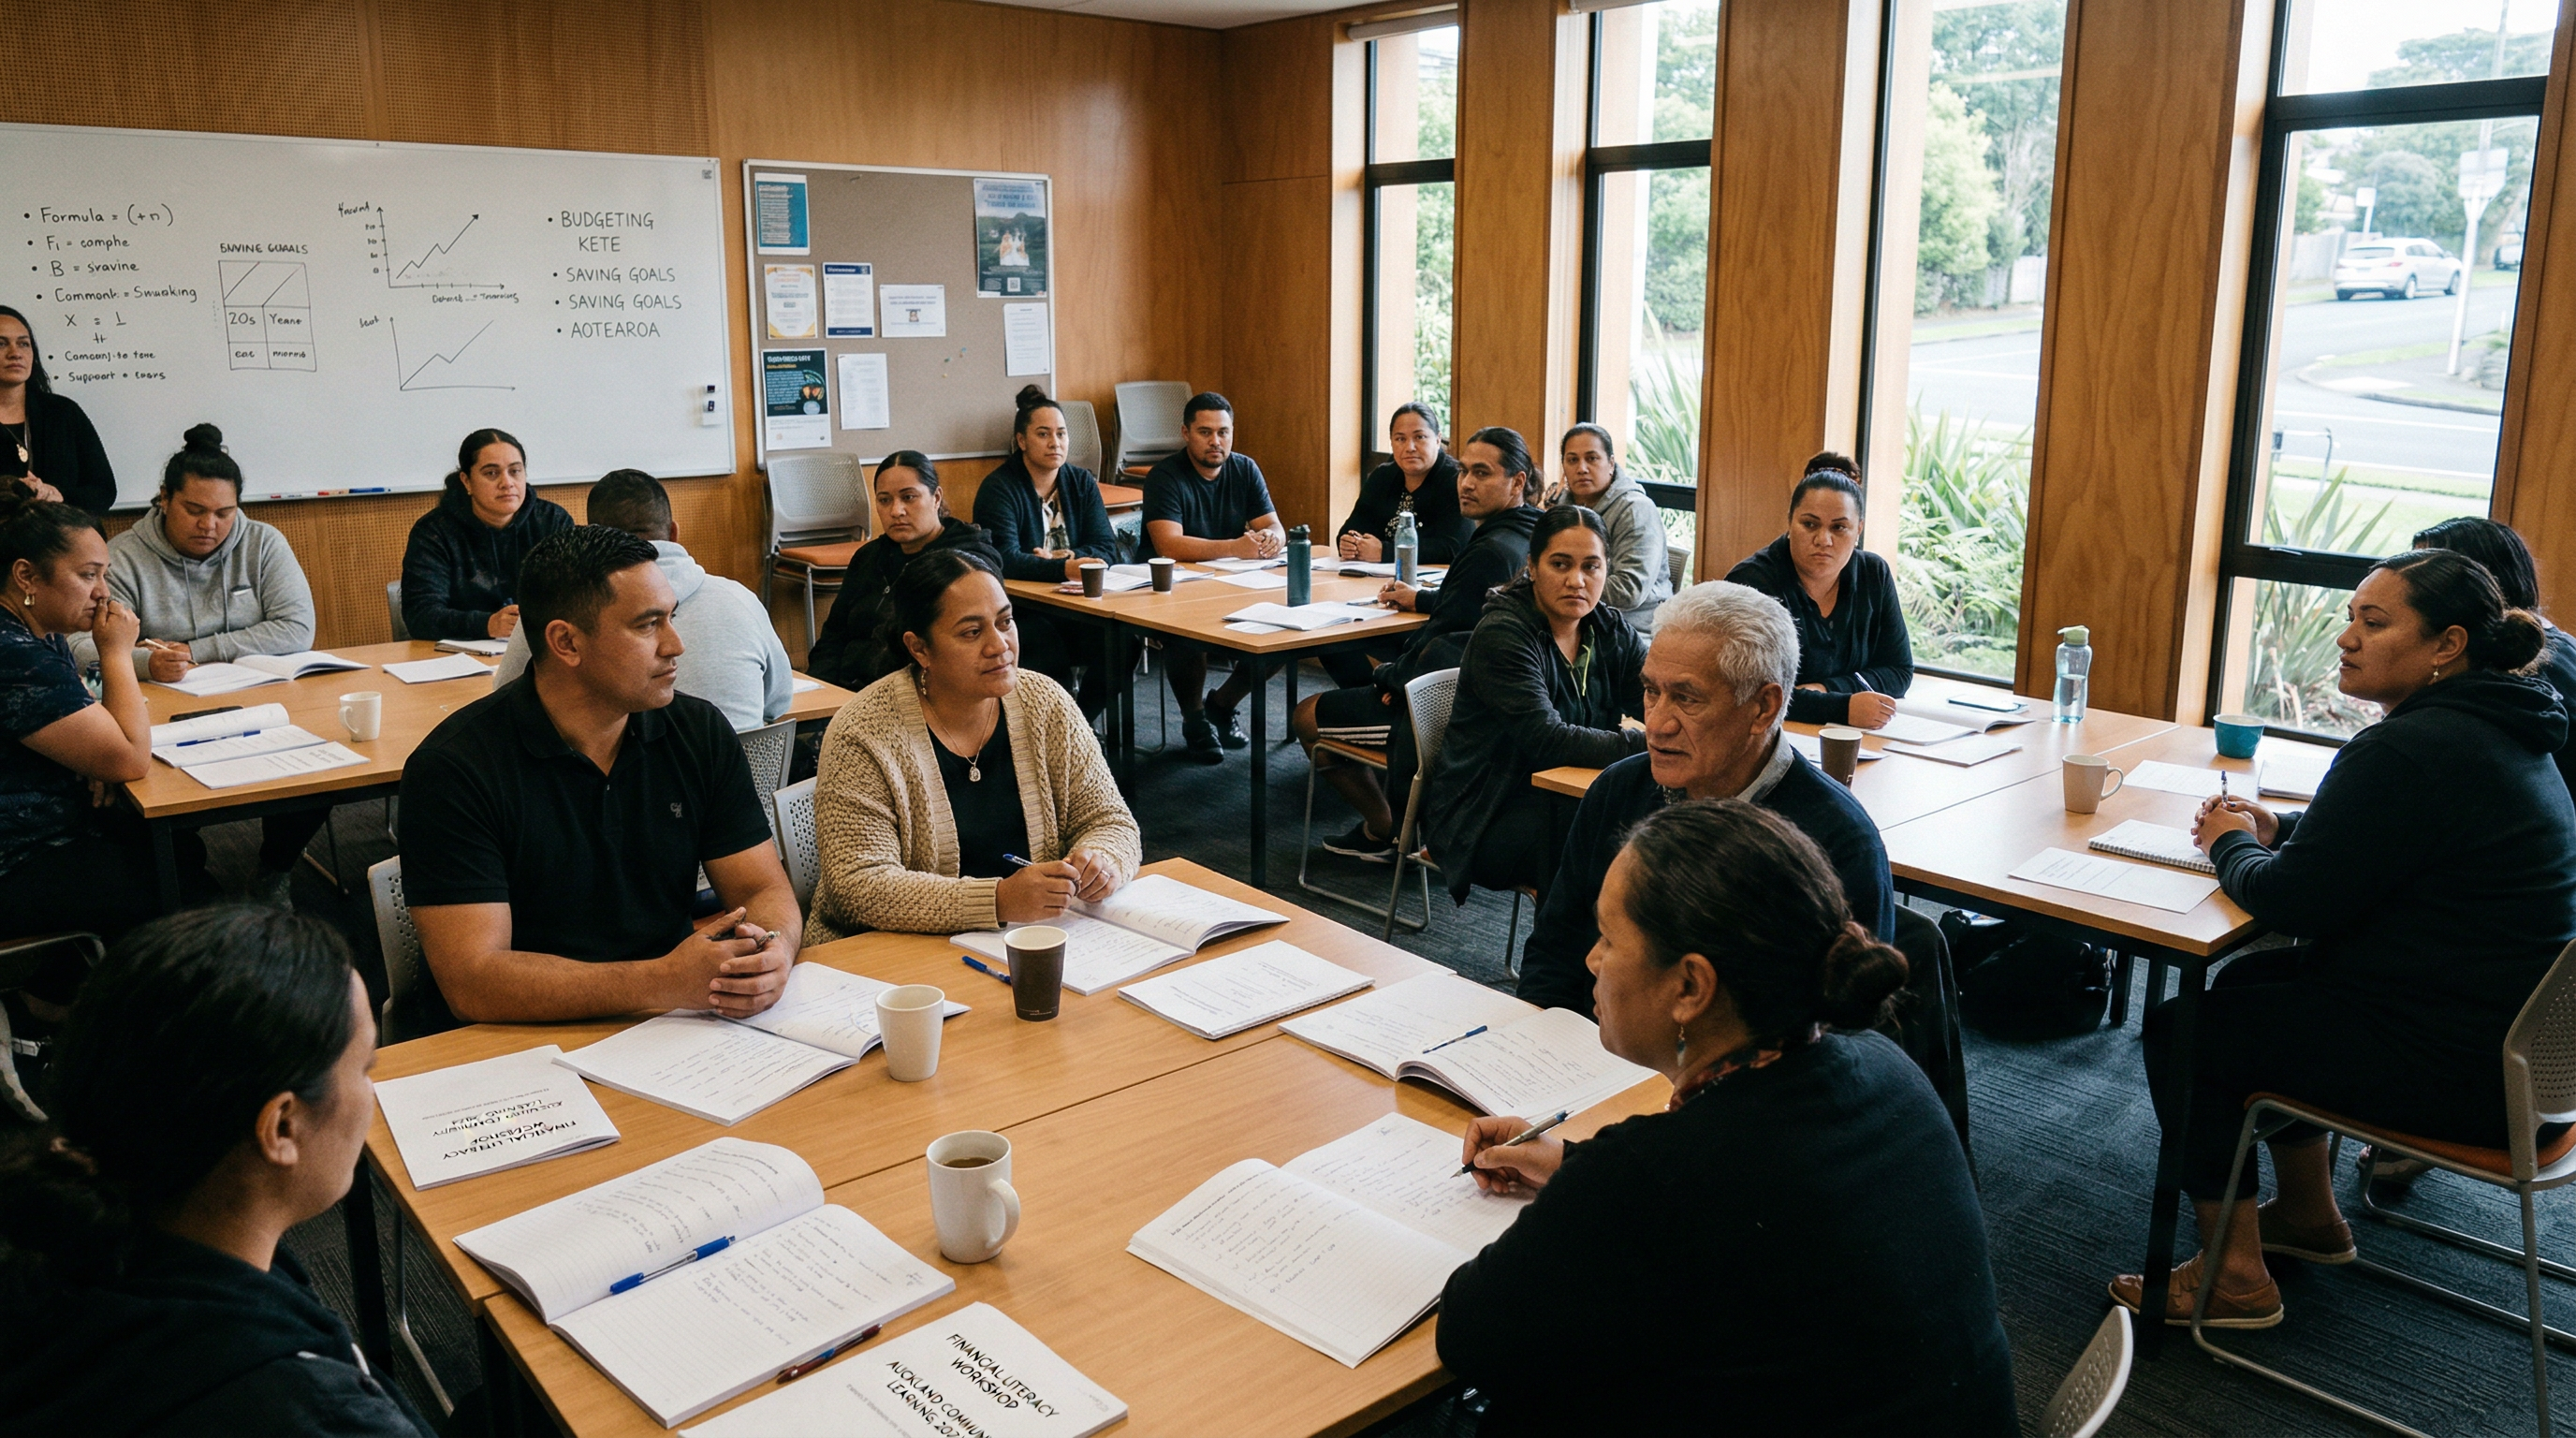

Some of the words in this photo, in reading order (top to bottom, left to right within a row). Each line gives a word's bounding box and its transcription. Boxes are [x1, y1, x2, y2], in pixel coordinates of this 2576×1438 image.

[40, 206, 105, 223] Formula
[561, 211, 654, 230] BUDGETING
[578, 235, 621, 252] KETE
[50, 259, 65, 277] B
[566, 267, 622, 283] SAVING
[629, 267, 676, 284] GOALS
[569, 294, 624, 311] SAVING
[633, 294, 682, 311] GOALS
[571, 321, 661, 338] AOTEAROA
[886, 1361, 944, 1404] AUCKLAND
[946, 1334, 1005, 1380] FINANCIAL
[1002, 1375, 1060, 1417] LITERACY
